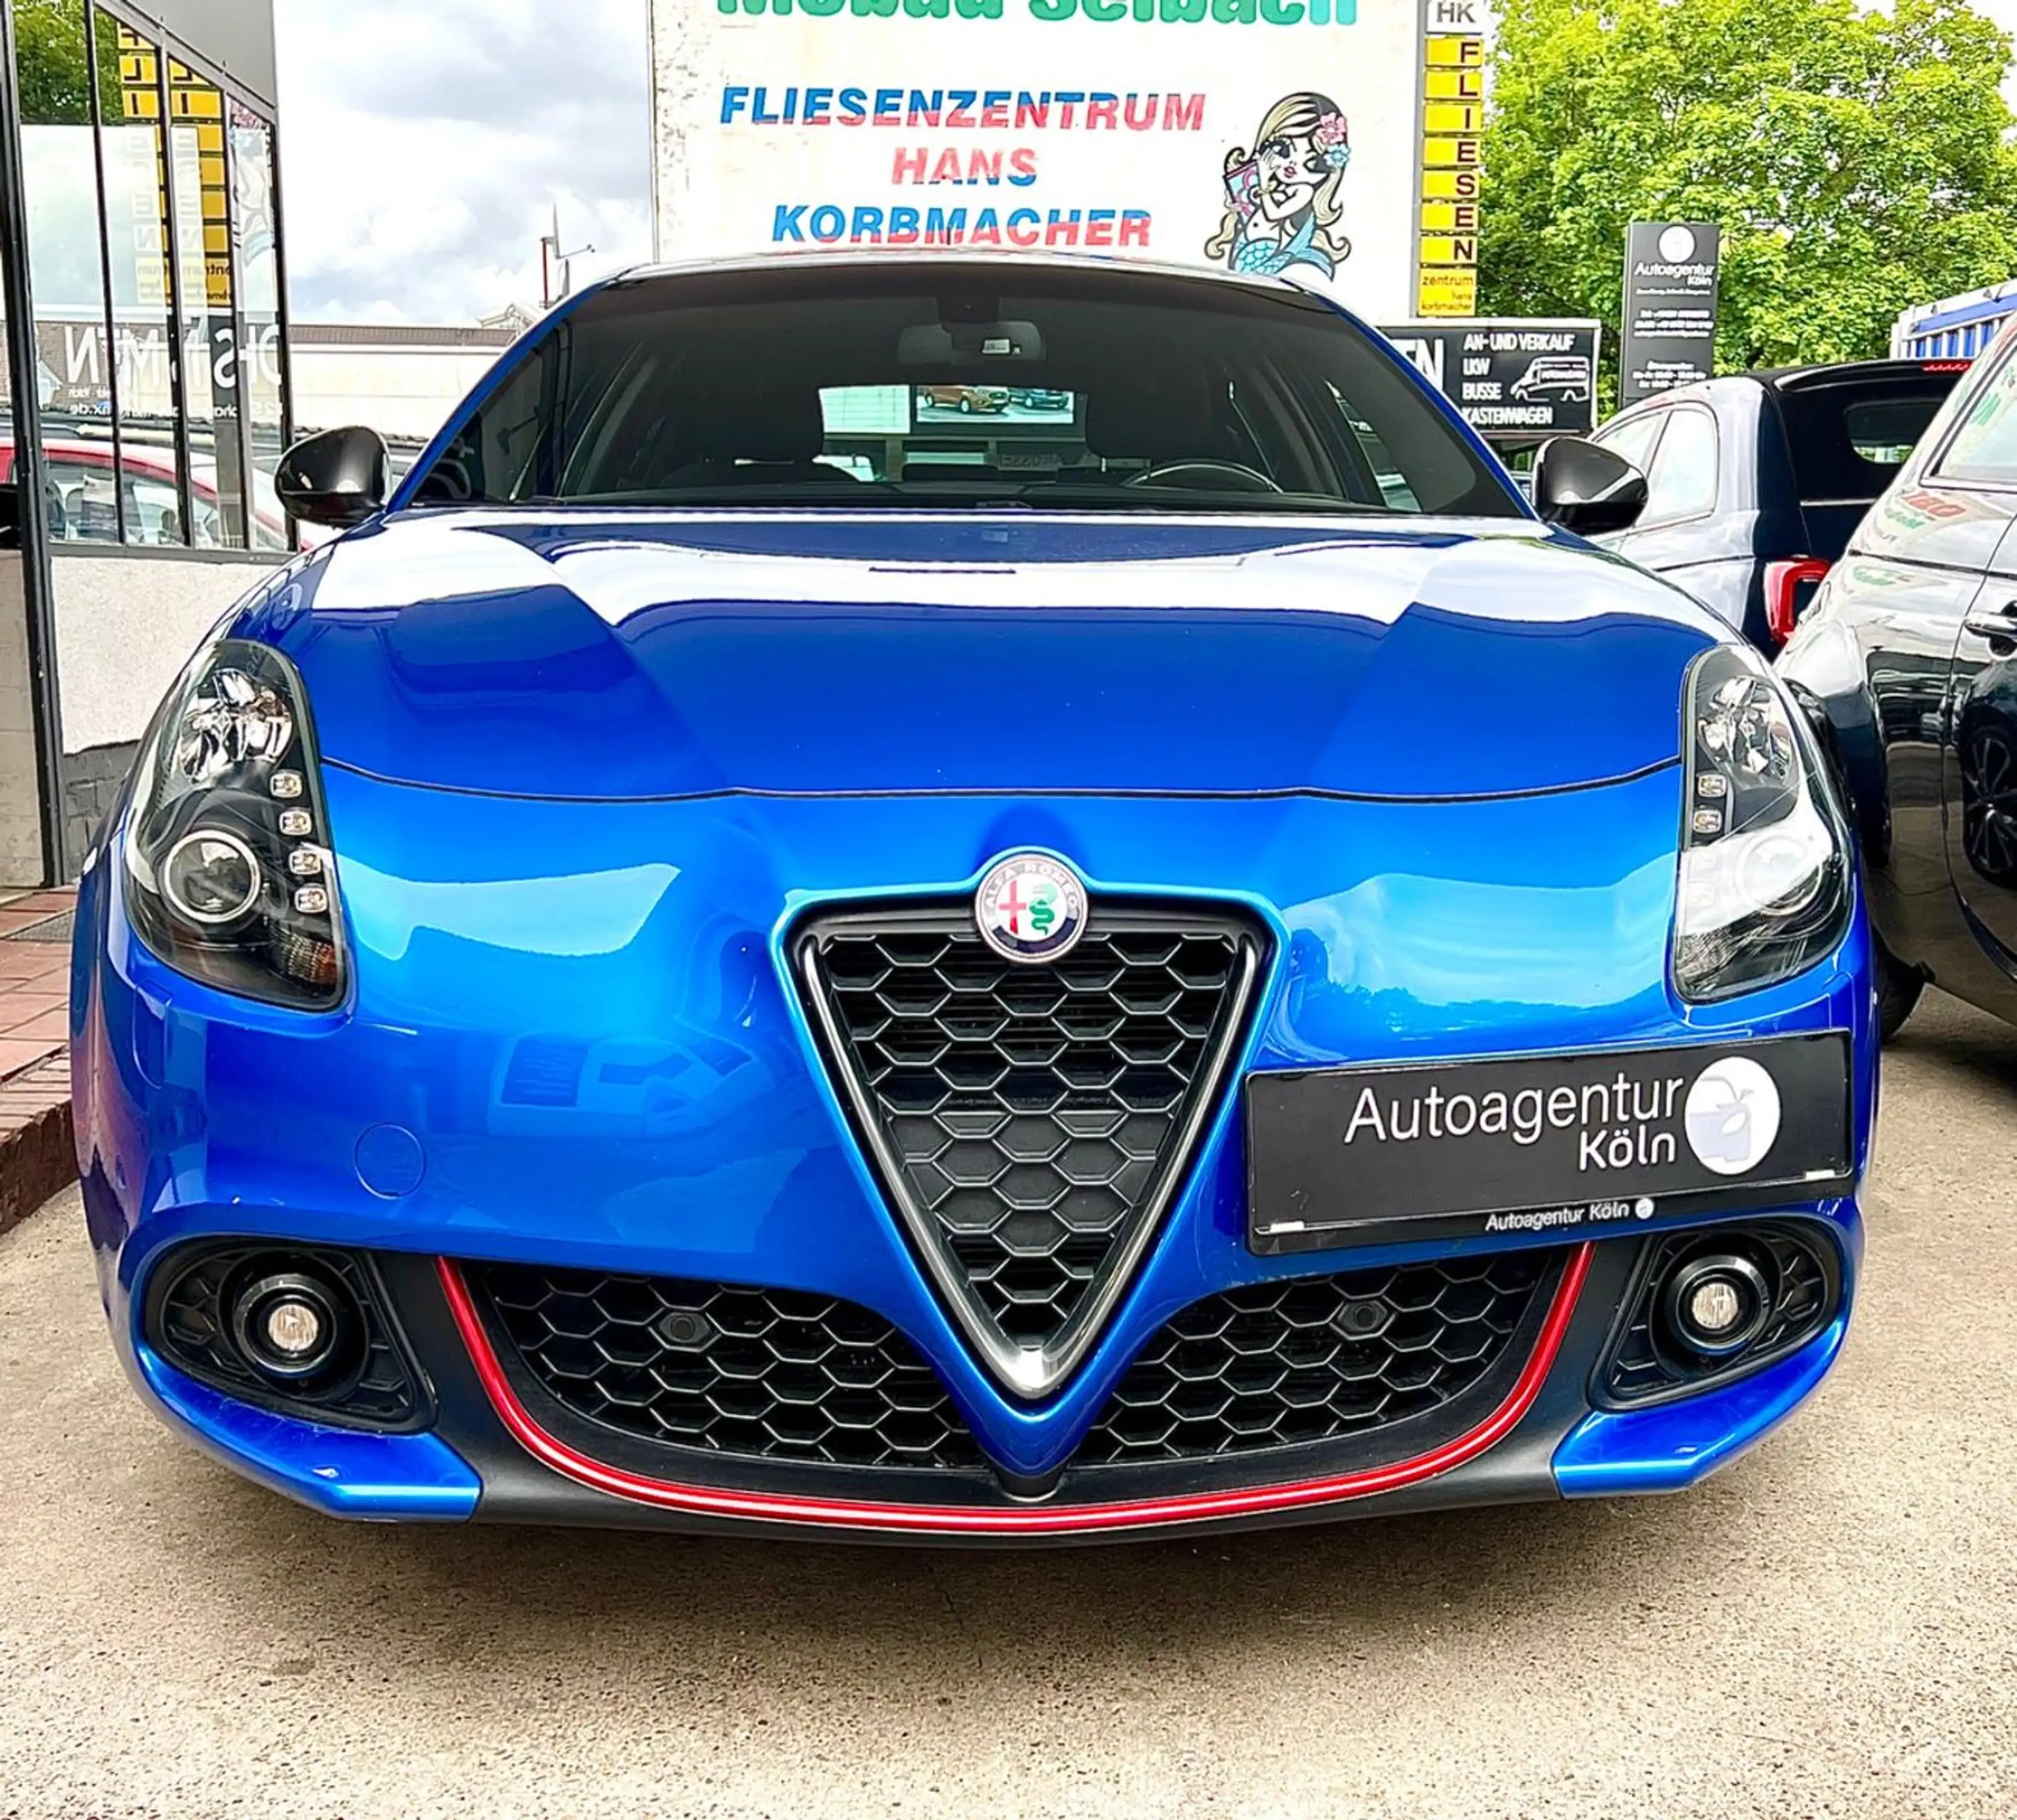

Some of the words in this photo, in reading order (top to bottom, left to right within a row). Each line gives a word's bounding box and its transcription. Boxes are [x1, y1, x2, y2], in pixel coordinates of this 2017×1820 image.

[1436, 2, 1476, 23] HK
[720, 87, 1206, 131] FLIESENZENTRUM
[1453, 42, 1480, 260] FLIESEN
[892, 147, 1038, 186] HANS
[772, 205, 1152, 246] KORBMACHER
[1422, 276, 1474, 286] zentrum
[1634, 262, 1715, 279] Autoagentur
[1489, 333, 1517, 350] UND
[1518, 333, 1575, 351] VERKAUF
[1462, 382, 1503, 400] BUSSE
[1461, 406, 1553, 424] KASTENWAGEN
[1343, 1072, 1684, 1144] Autoagentur
[1578, 1125, 1676, 1172] Köln
[1485, 1207, 1586, 1231] Autoagentur
[1589, 1201, 1630, 1221] Köln
